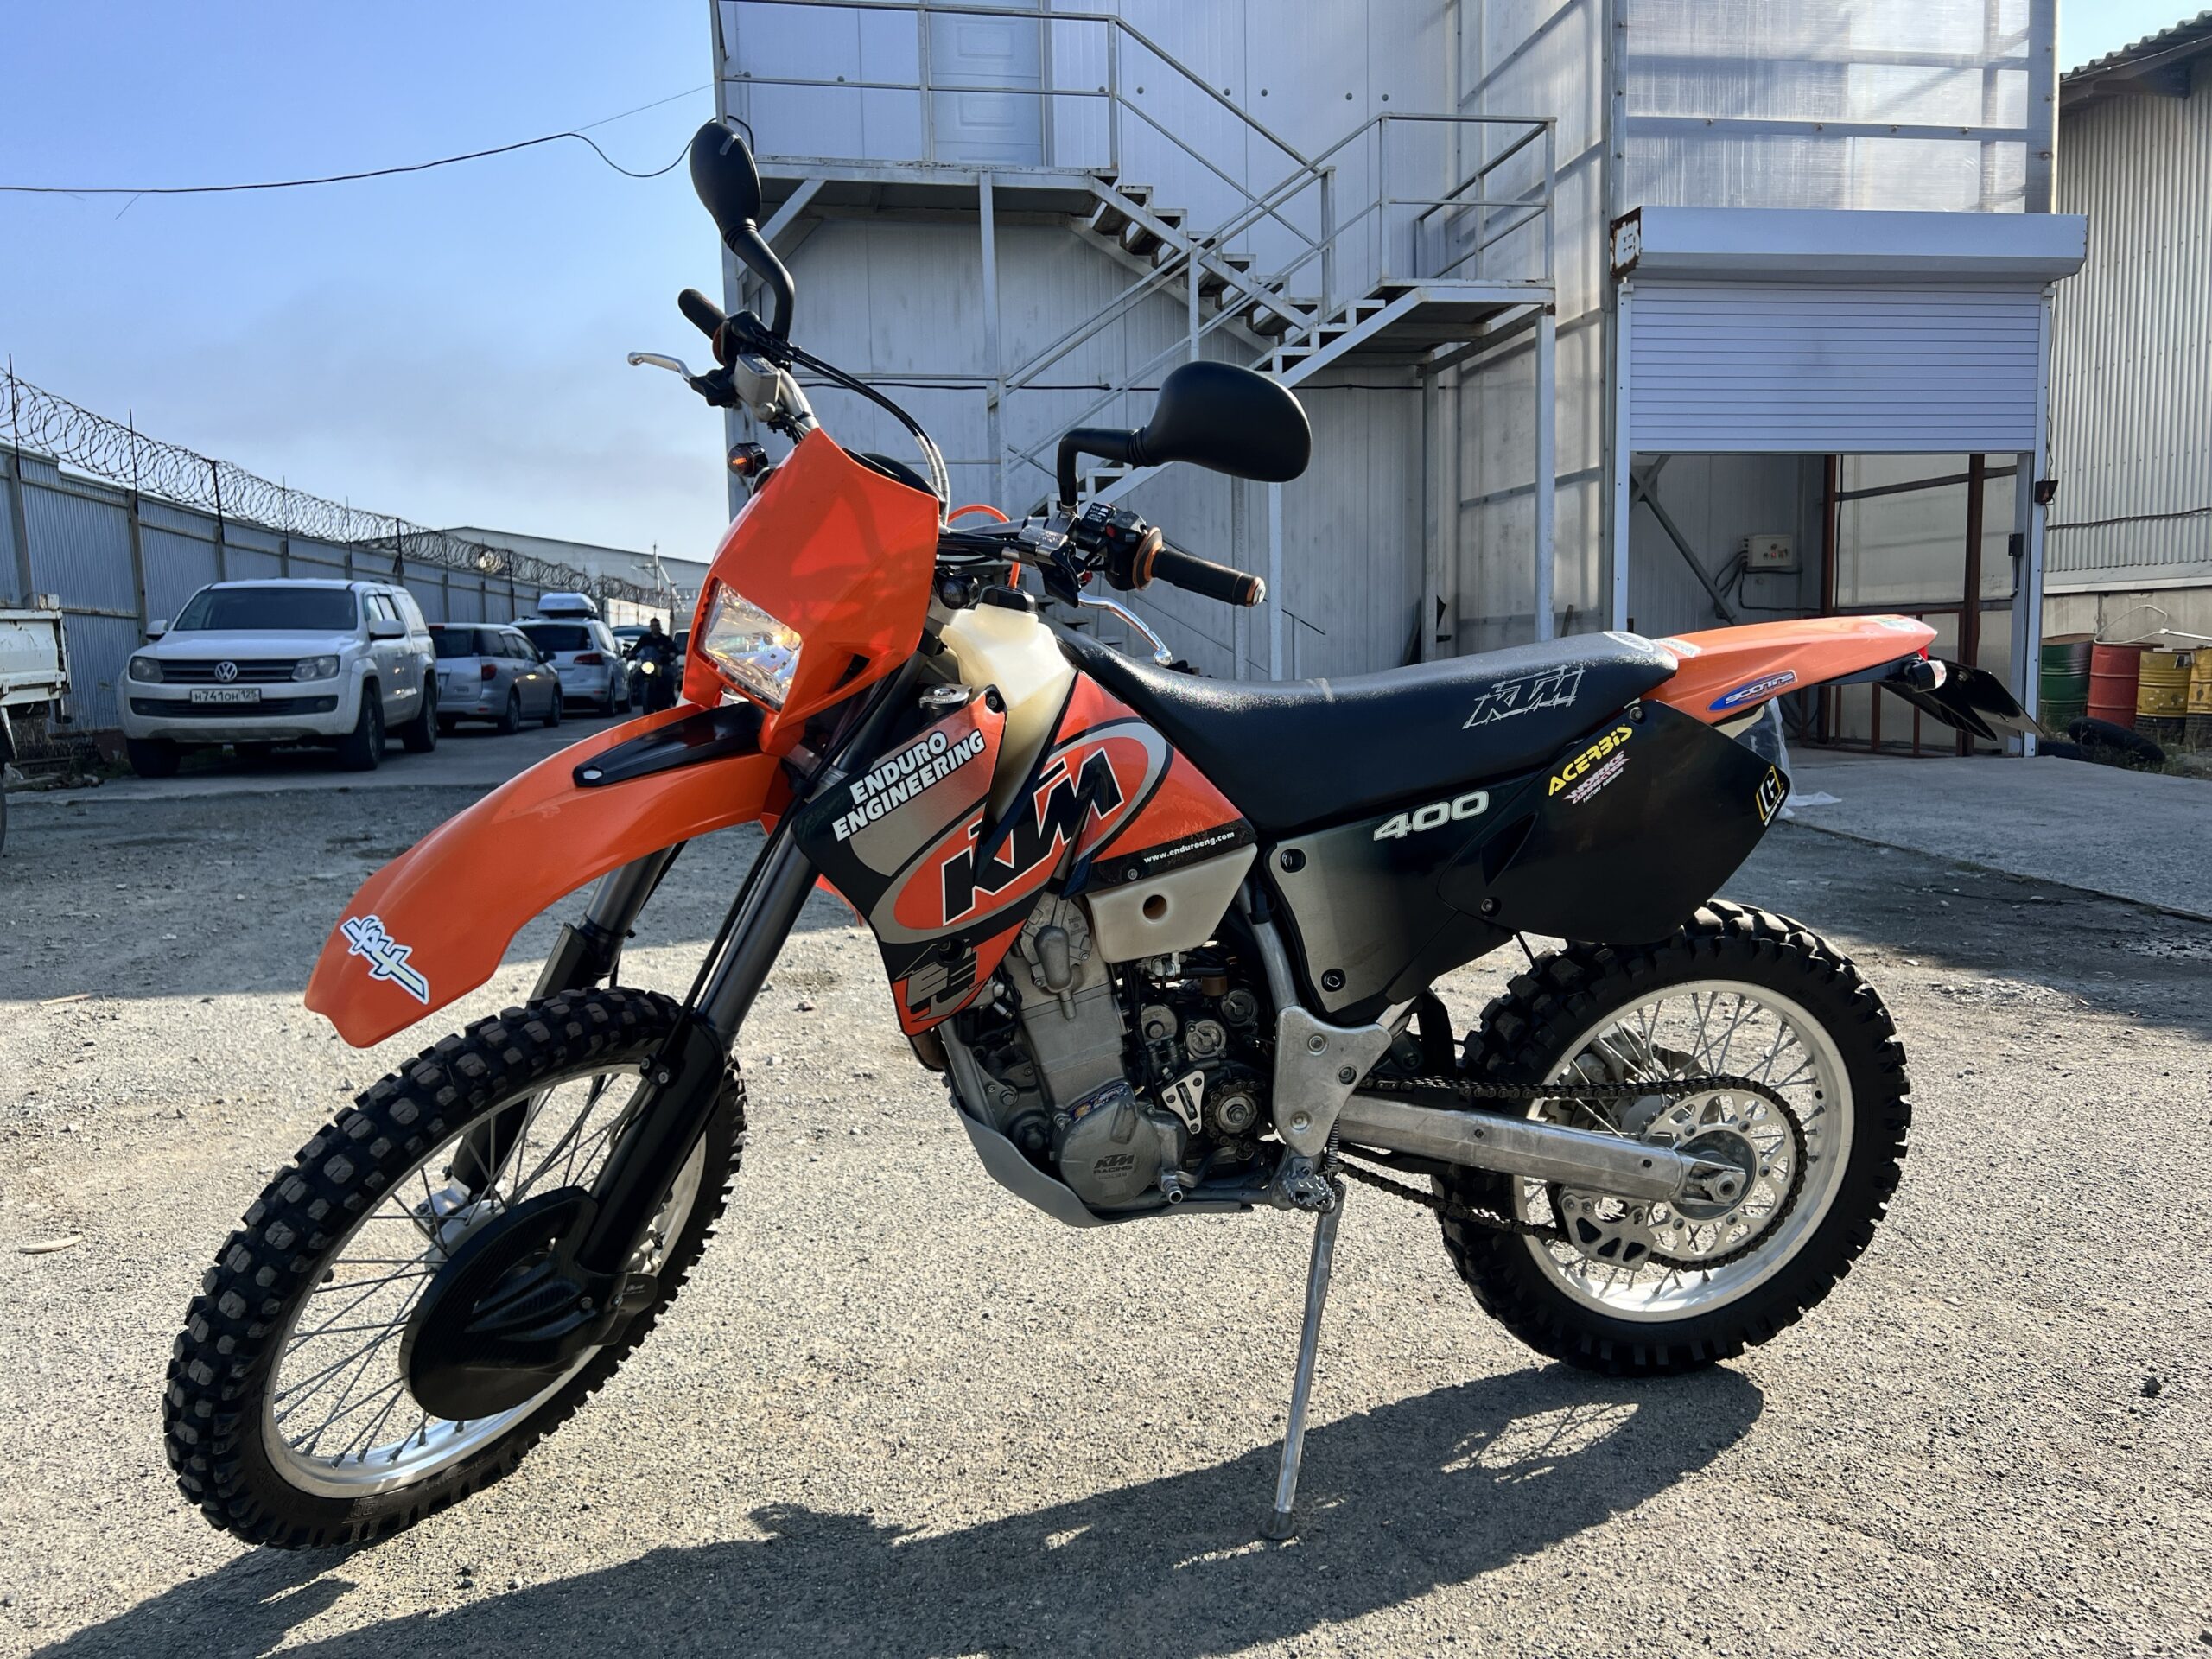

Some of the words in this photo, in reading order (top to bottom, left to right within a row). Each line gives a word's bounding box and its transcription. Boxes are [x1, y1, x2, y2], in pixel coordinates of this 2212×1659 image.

[1462, 664, 1586, 729] KTM
[831, 729, 987, 842] ENGINEERING
[849, 731, 948, 805] ENDURO
[1548, 726, 1633, 797] ACERBIS
[941, 746, 1125, 927] KTM
[1143, 831, 1235, 863] www.enduroeng.com
[1373, 790, 1490, 842] 400
[1093, 1166, 1133, 1174] RACING
[1094, 1154, 1135, 1169] KTM
